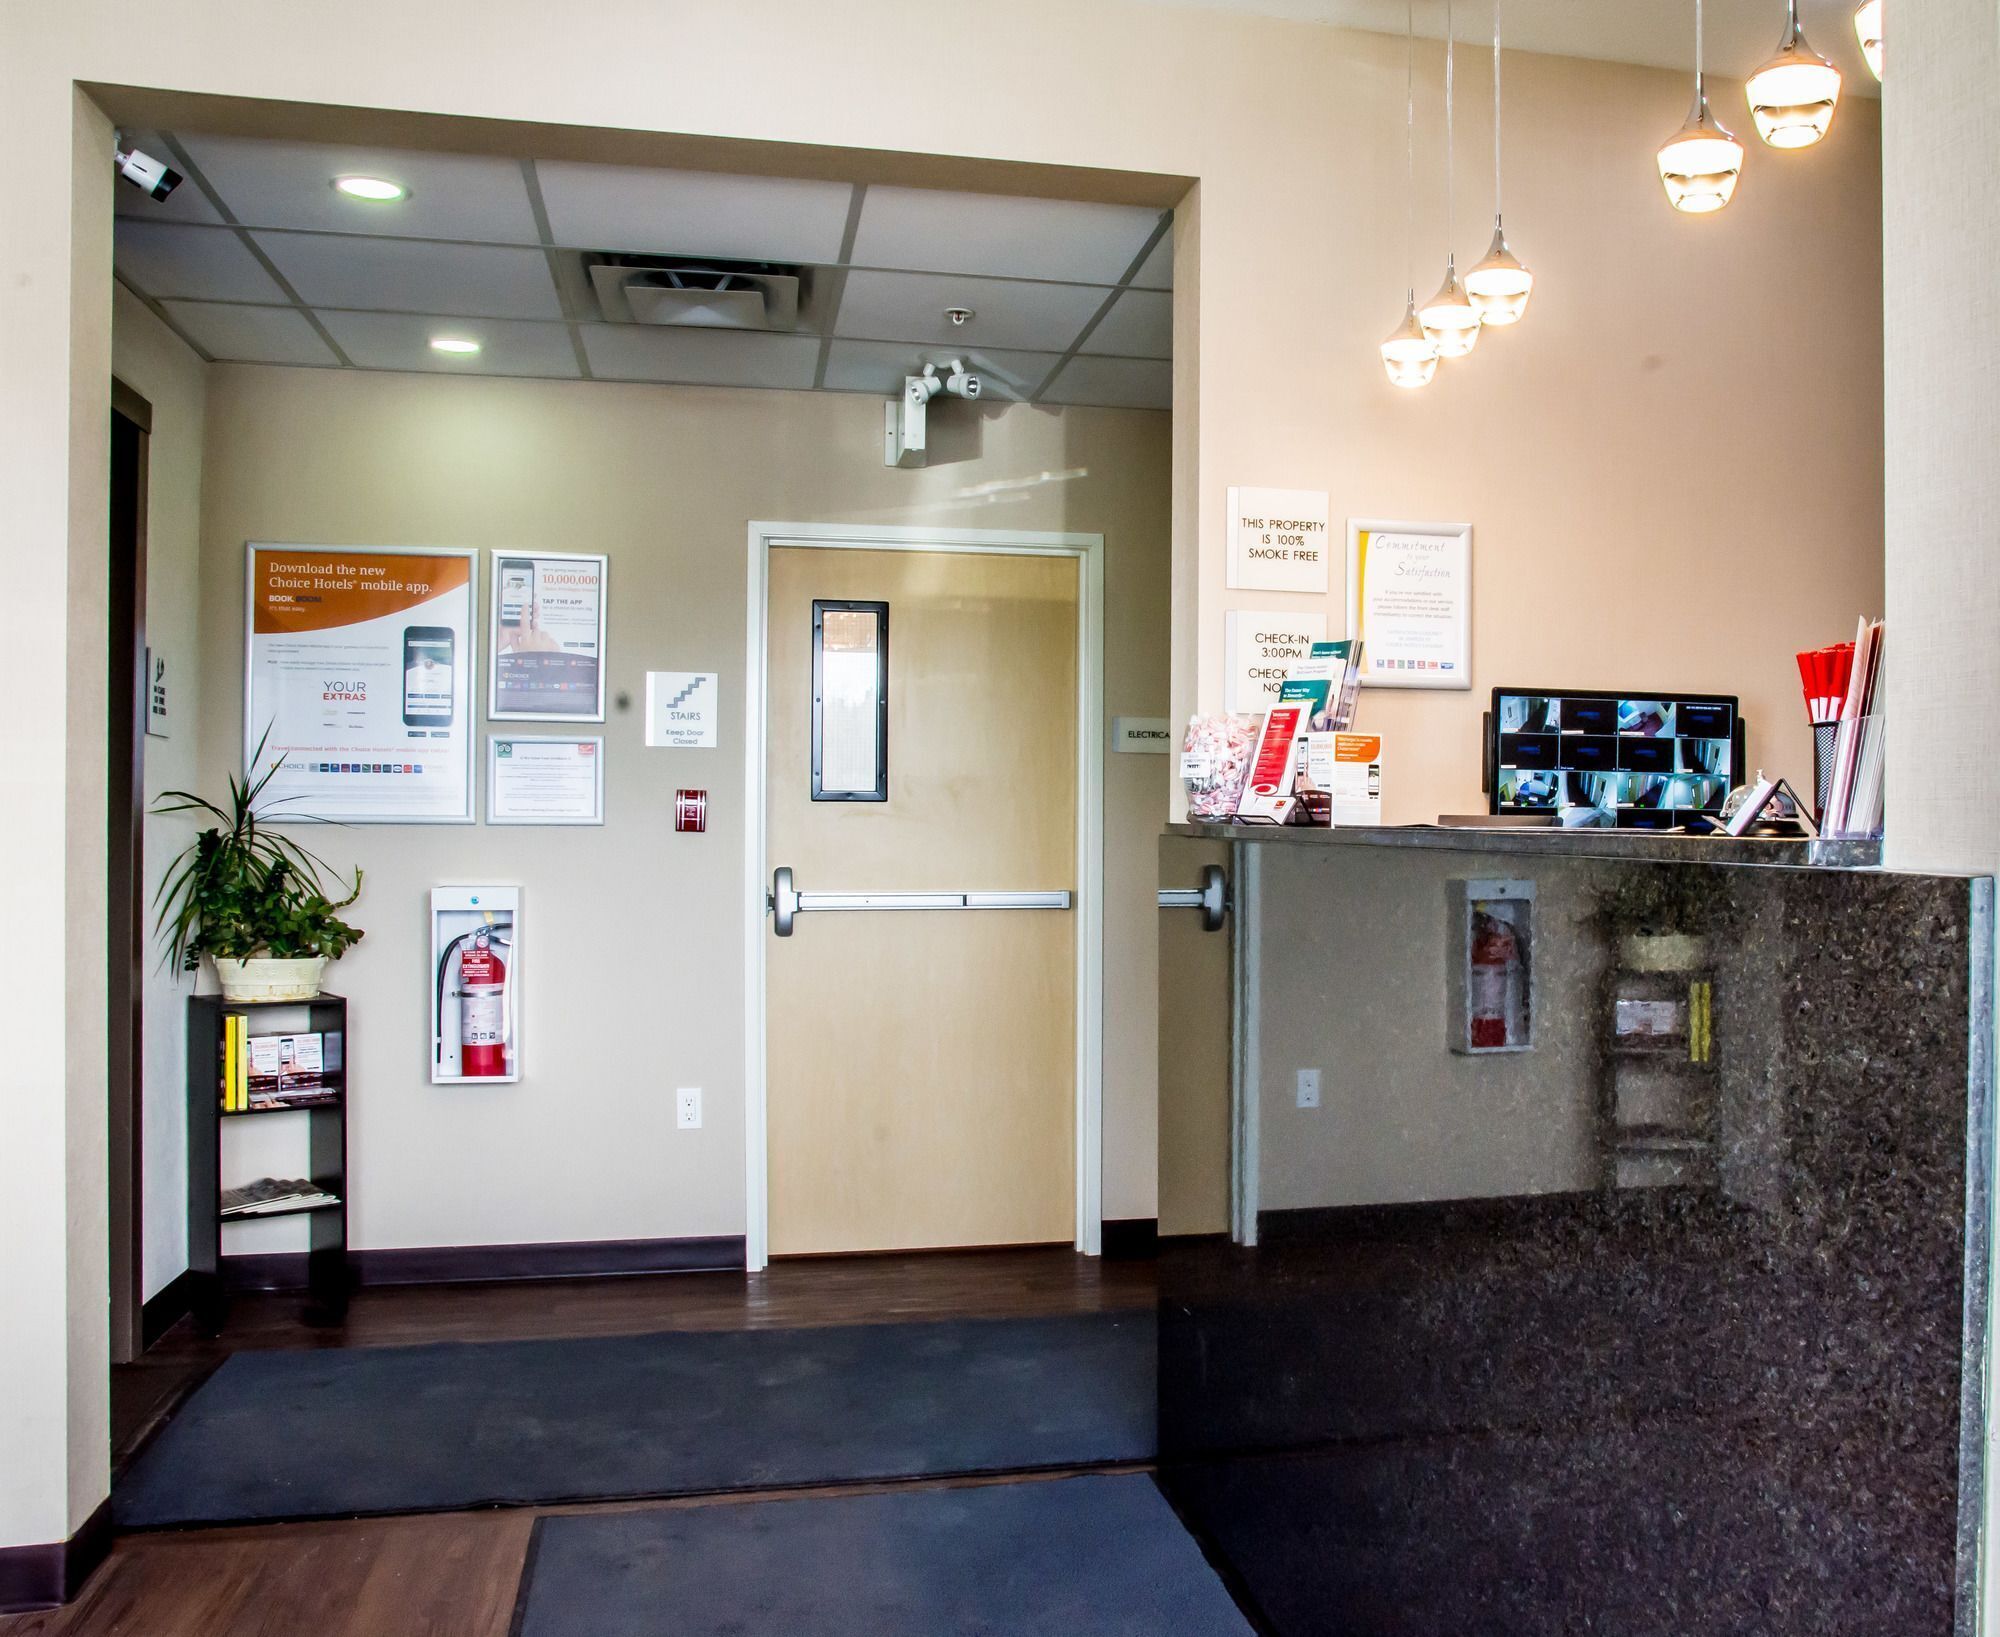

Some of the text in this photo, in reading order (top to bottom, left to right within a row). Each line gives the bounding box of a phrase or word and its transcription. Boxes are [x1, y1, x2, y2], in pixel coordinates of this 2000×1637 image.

[1241, 517, 1326, 532] THIS PROPERTY
[1262, 534, 1305, 546] IS 100%
[1375, 535, 1447, 552] Commitment
[1248, 548, 1319, 561] SMOKE FREE
[269, 562, 386, 576] Download the new
[1393, 561, 1451, 582] Satisfaction
[269, 576, 311, 589] Choice
[360, 580, 403, 591] mobile
[406, 583, 433, 595] app.
[543, 574, 598, 585] 10,000,000
[1254, 633, 1310, 645] CHECK-IN
[1261, 647, 1303, 658] 3:00PM
[1248, 667, 1288, 679] CHECK
[323, 680, 366, 693] YOUR
[1263, 683, 1282, 693] NO
[322, 692, 367, 701] EXTRAS
[670, 711, 701, 721] STAIRS
[666, 729, 685, 737] Keep
[1128, 730, 1170, 739] ELECTRICA
[672, 737, 698, 745] Closed
